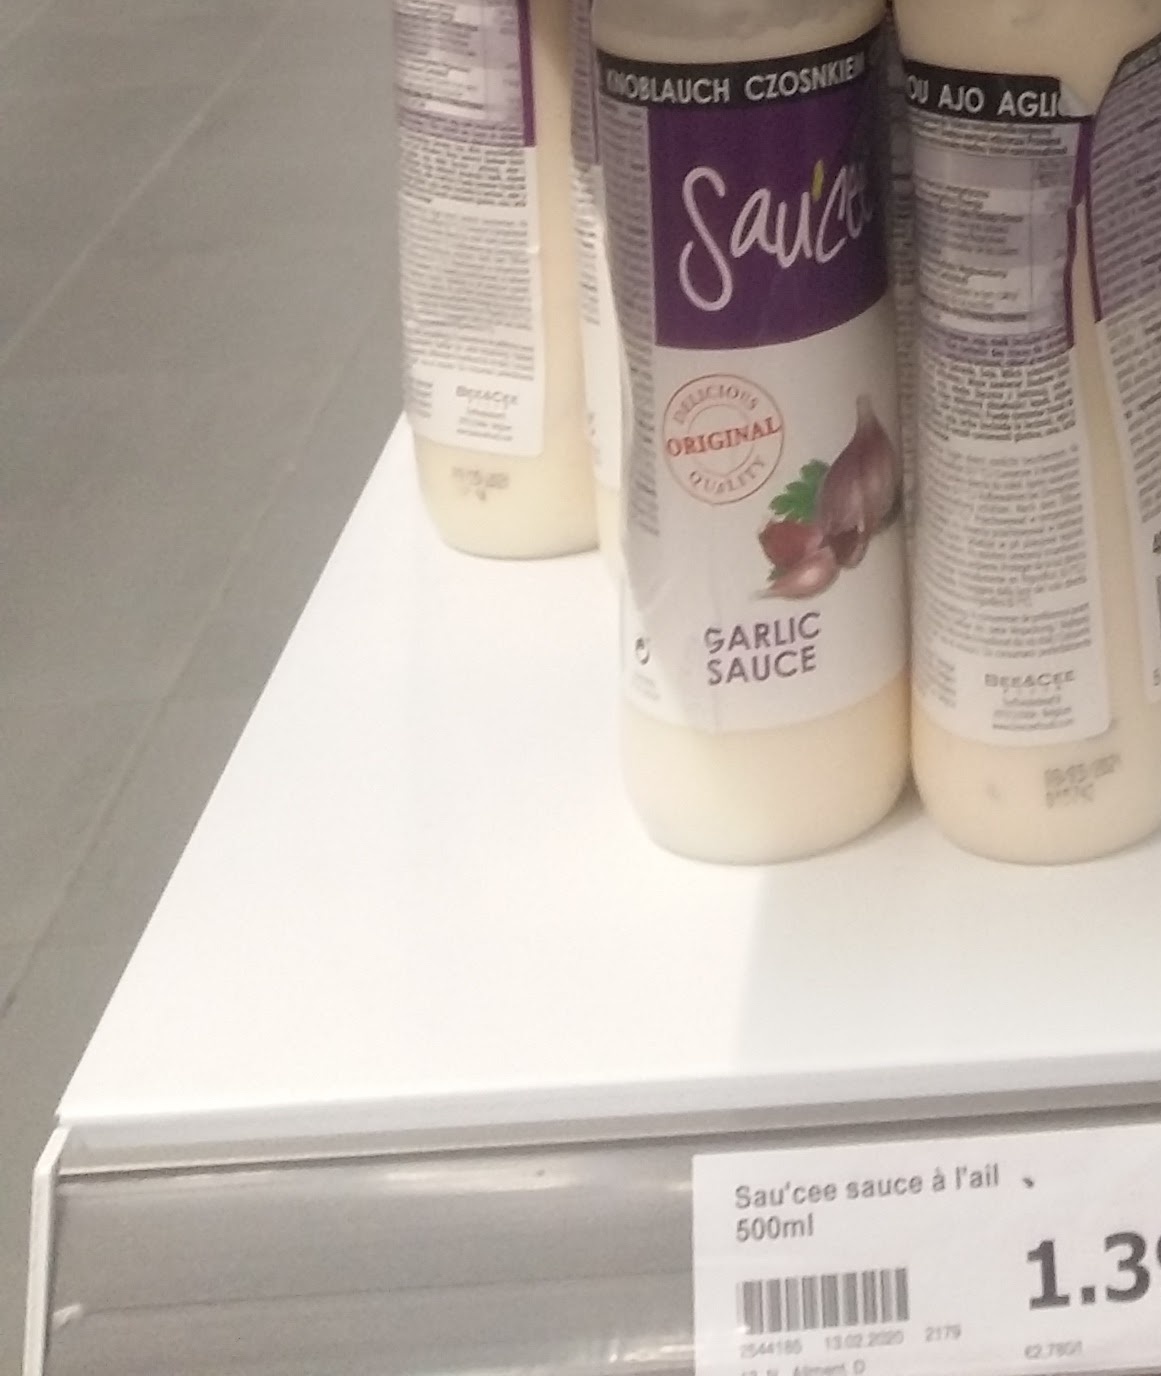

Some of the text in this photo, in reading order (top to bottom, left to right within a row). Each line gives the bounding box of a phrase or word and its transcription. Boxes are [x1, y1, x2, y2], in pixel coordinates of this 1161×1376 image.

[938, 84, 986, 113] AJO
[673, 385, 759, 426] DELICIOUS
[666, 416, 781, 458] ORIGINAL
[689, 453, 766, 494] QUALITY
[704, 610, 822, 654] GARLIC
[707, 645, 817, 686] SAUCE
[735, 1163, 1000, 1210] Sau'cee sauce à l'ail
[736, 1213, 815, 1243] 500ml
